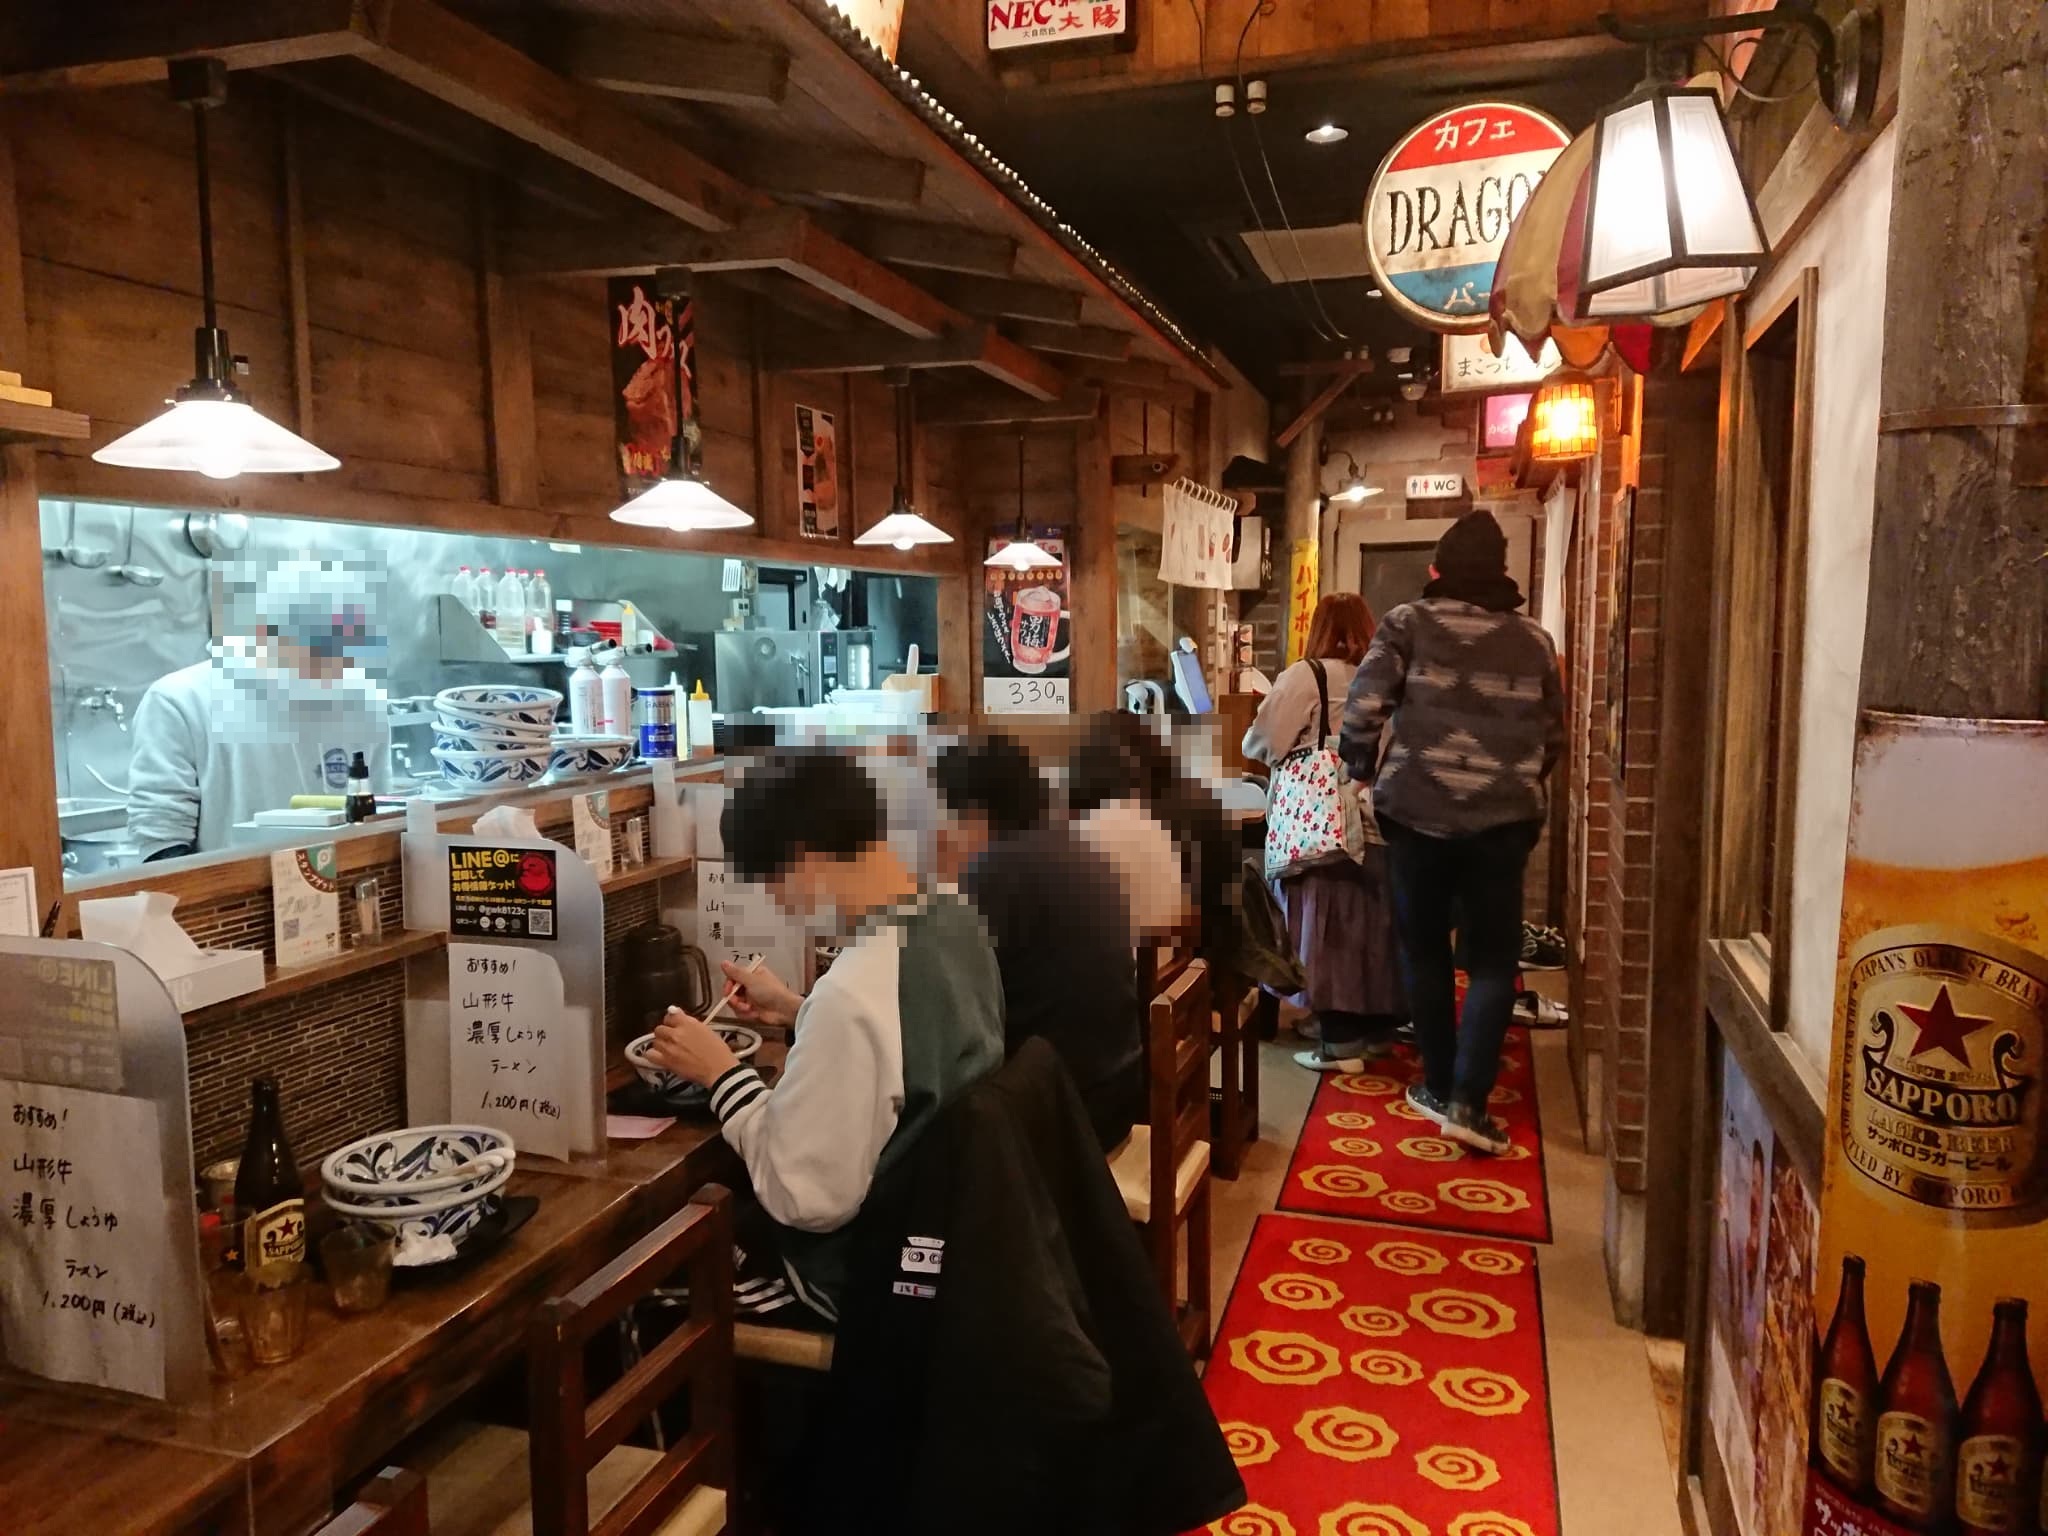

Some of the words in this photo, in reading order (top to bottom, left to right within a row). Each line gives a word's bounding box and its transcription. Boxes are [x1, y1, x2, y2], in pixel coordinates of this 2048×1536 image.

[990, 0, 1053, 32] NEC
[1435, 118, 1515, 151] カフェ
[1386, 170, 1547, 256] DRAGO
[1433, 479, 1456, 491] WC
[1008, 680, 1065, 706] 330円
[451, 849, 520, 870] LINE@に
[1859, 950, 1907, 983] JAPAN'S
[462, 992, 515, 1012] 山形牛
[490, 1059, 537, 1074] ラーメン
[1867, 1066, 2018, 1124] SAPPORO
[1867, 1104, 1942, 1149] LAGER
[1949, 1131, 2015, 1153] BEER
[1867, 1126, 2014, 1172] サッポロラガービール
[13, 1153, 73, 1184] 山形牛
[64, 1259, 108, 1280] ラーメン
